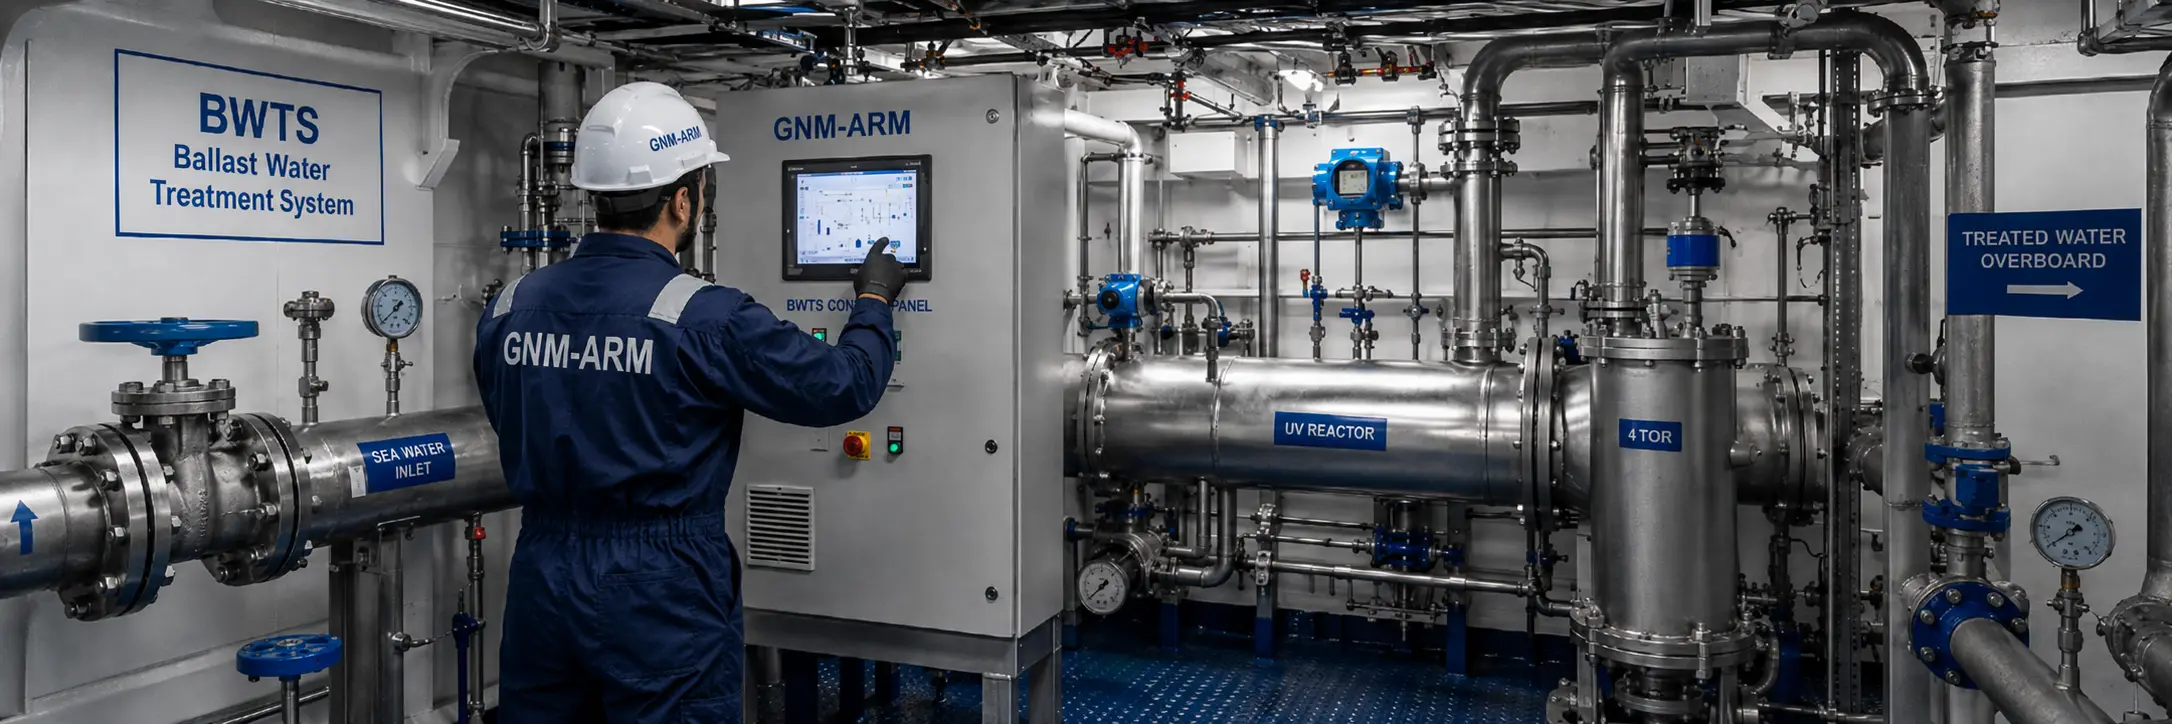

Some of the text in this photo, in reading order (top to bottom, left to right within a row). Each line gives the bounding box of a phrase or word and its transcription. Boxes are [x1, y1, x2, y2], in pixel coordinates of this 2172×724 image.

[199, 93, 319, 144] BWTS
[773, 110, 912, 142] GNM-ARM
[649, 125, 702, 152] GNM-ARM
[173, 143, 331, 181] Ballast Water
[149, 178, 355, 219] Treatment System
[1962, 228, 2127, 247] TREATED WATER
[1981, 252, 2107, 269] OVERBOARD
[786, 298, 824, 312] BWTS
[891, 299, 933, 313] PANEL
[503, 331, 654, 375] GNM-ARM
[1285, 422, 1375, 440] UV REACTOR
[371, 442, 446, 464] SEA WATER
[395, 461, 432, 479] INLET
